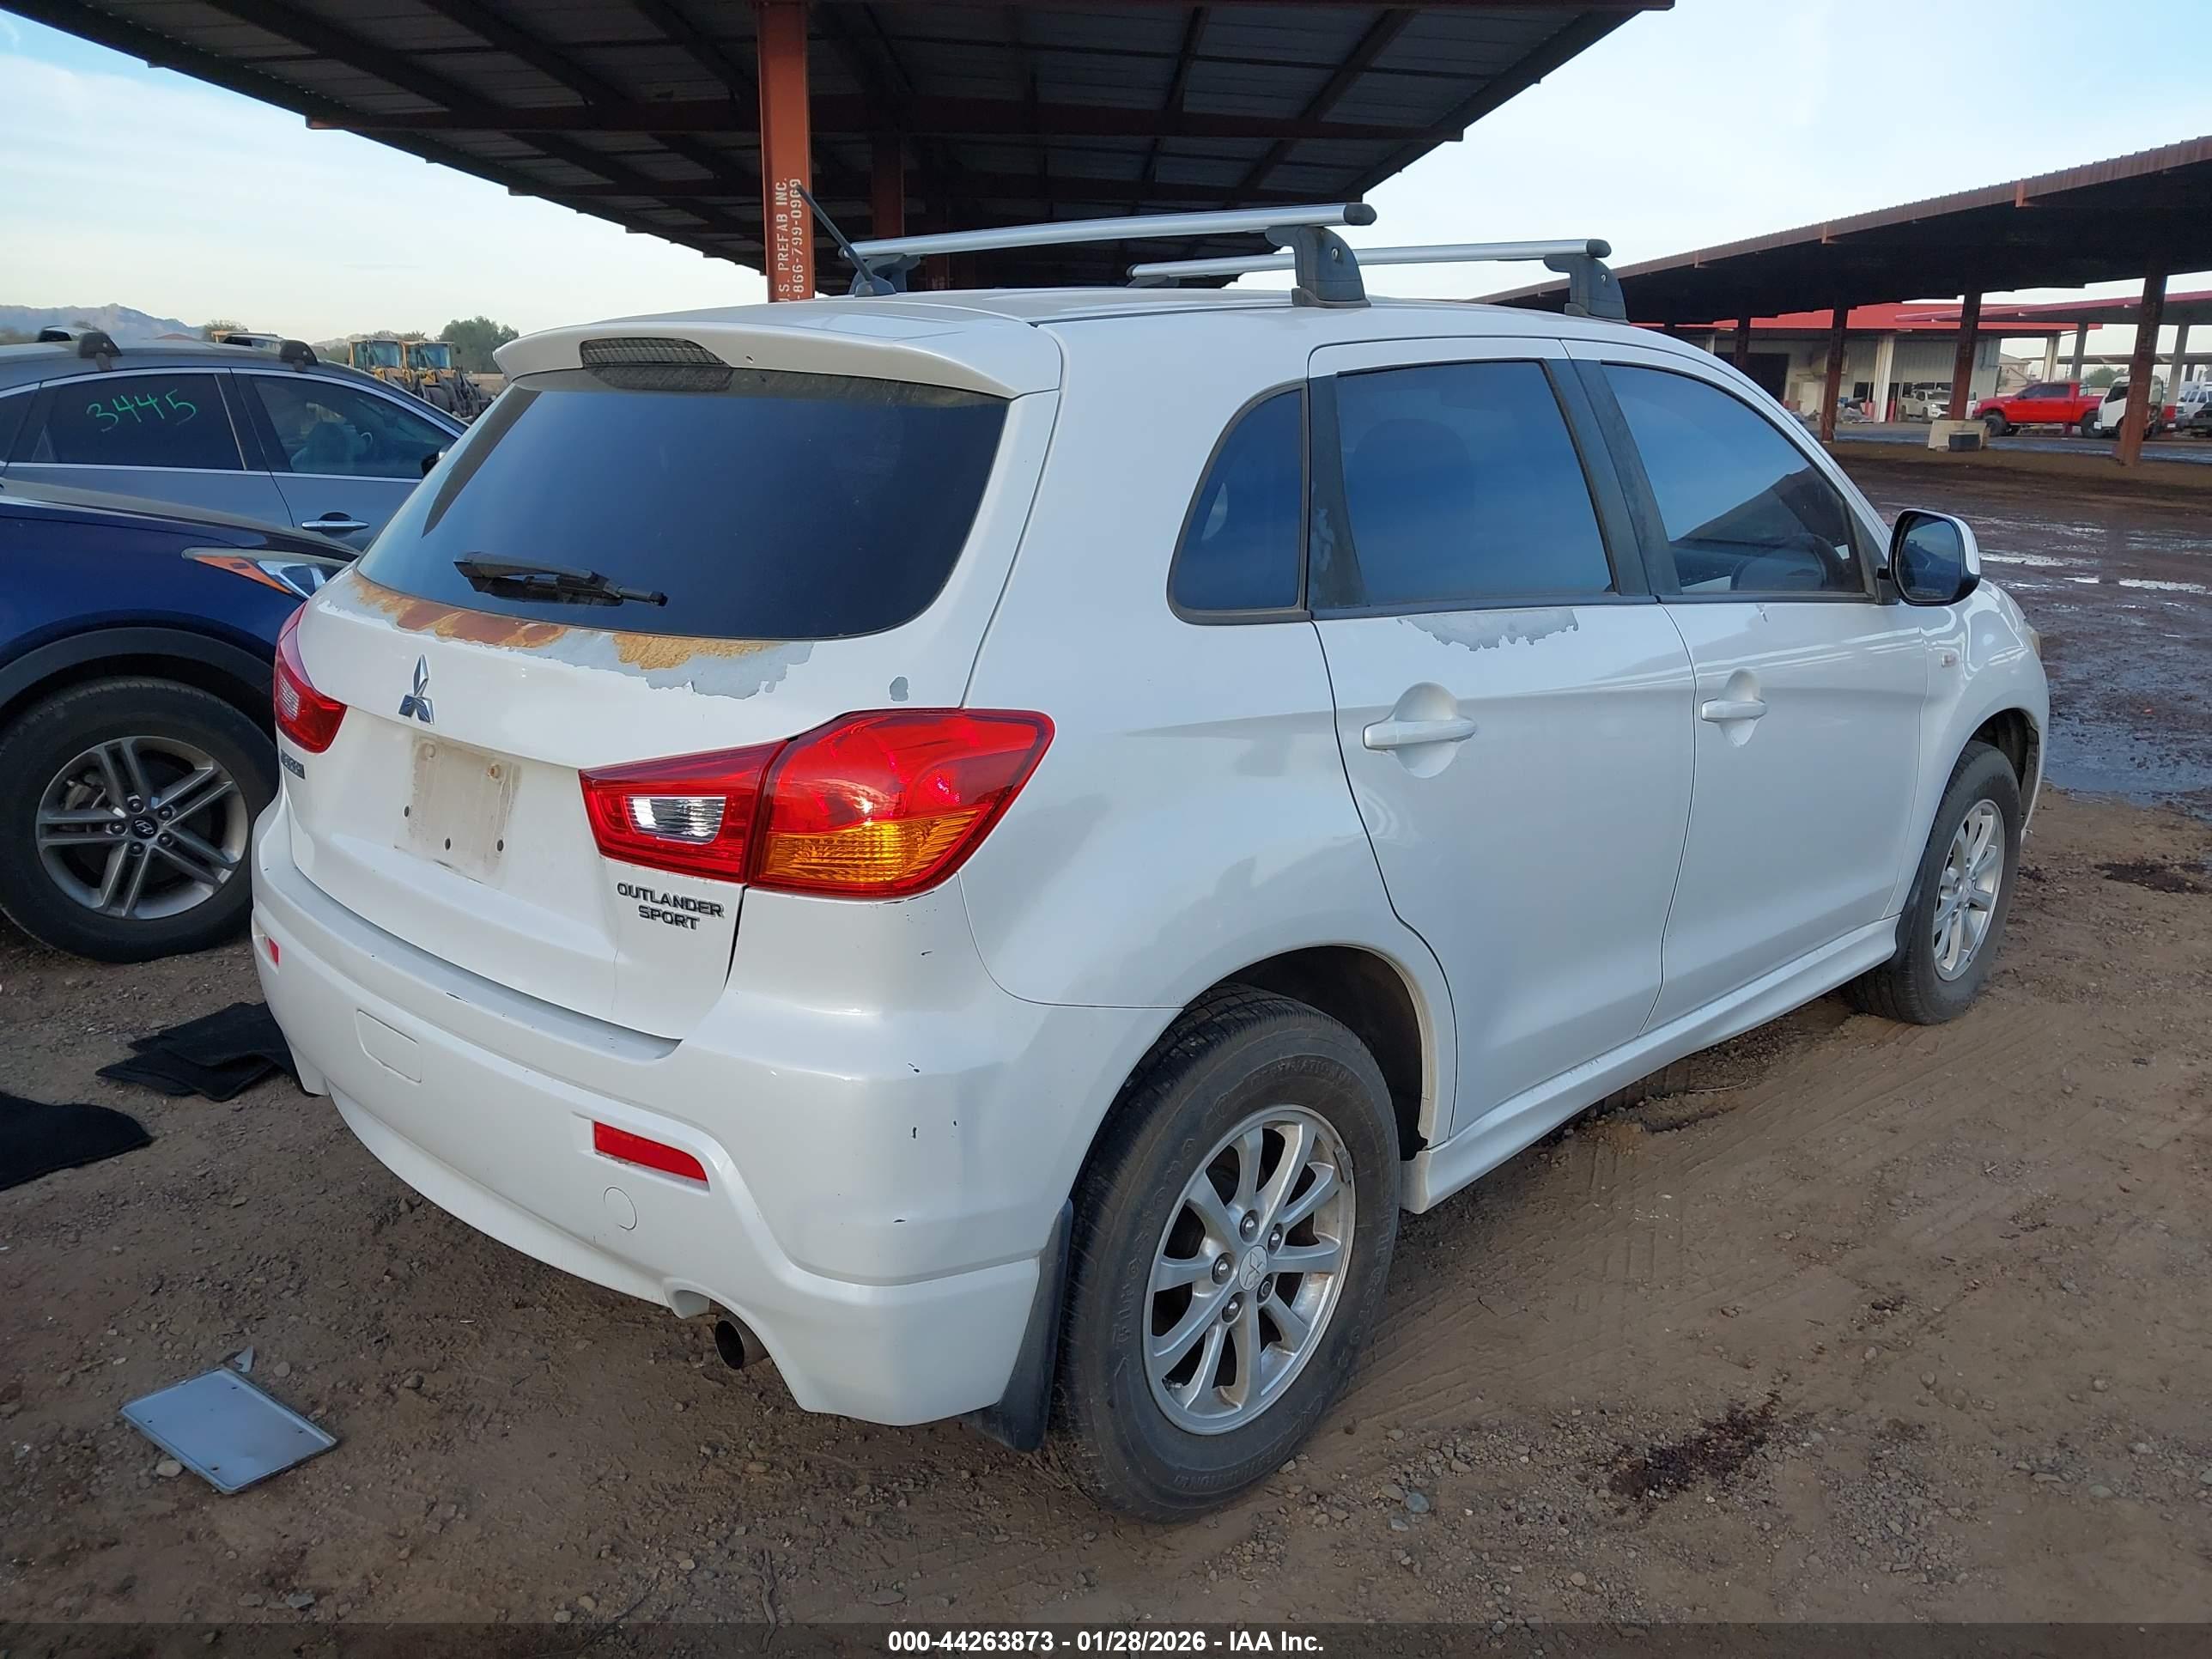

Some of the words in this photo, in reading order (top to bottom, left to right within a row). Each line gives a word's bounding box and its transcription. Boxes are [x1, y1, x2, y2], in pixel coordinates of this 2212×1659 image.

[775, 178, 788, 206] INC.
[776, 213, 789, 271] PREFAB
[87, 389, 197, 432] 3445
[617, 882, 725, 918] OUTLANDER
[638, 904, 701, 930] SPORT
